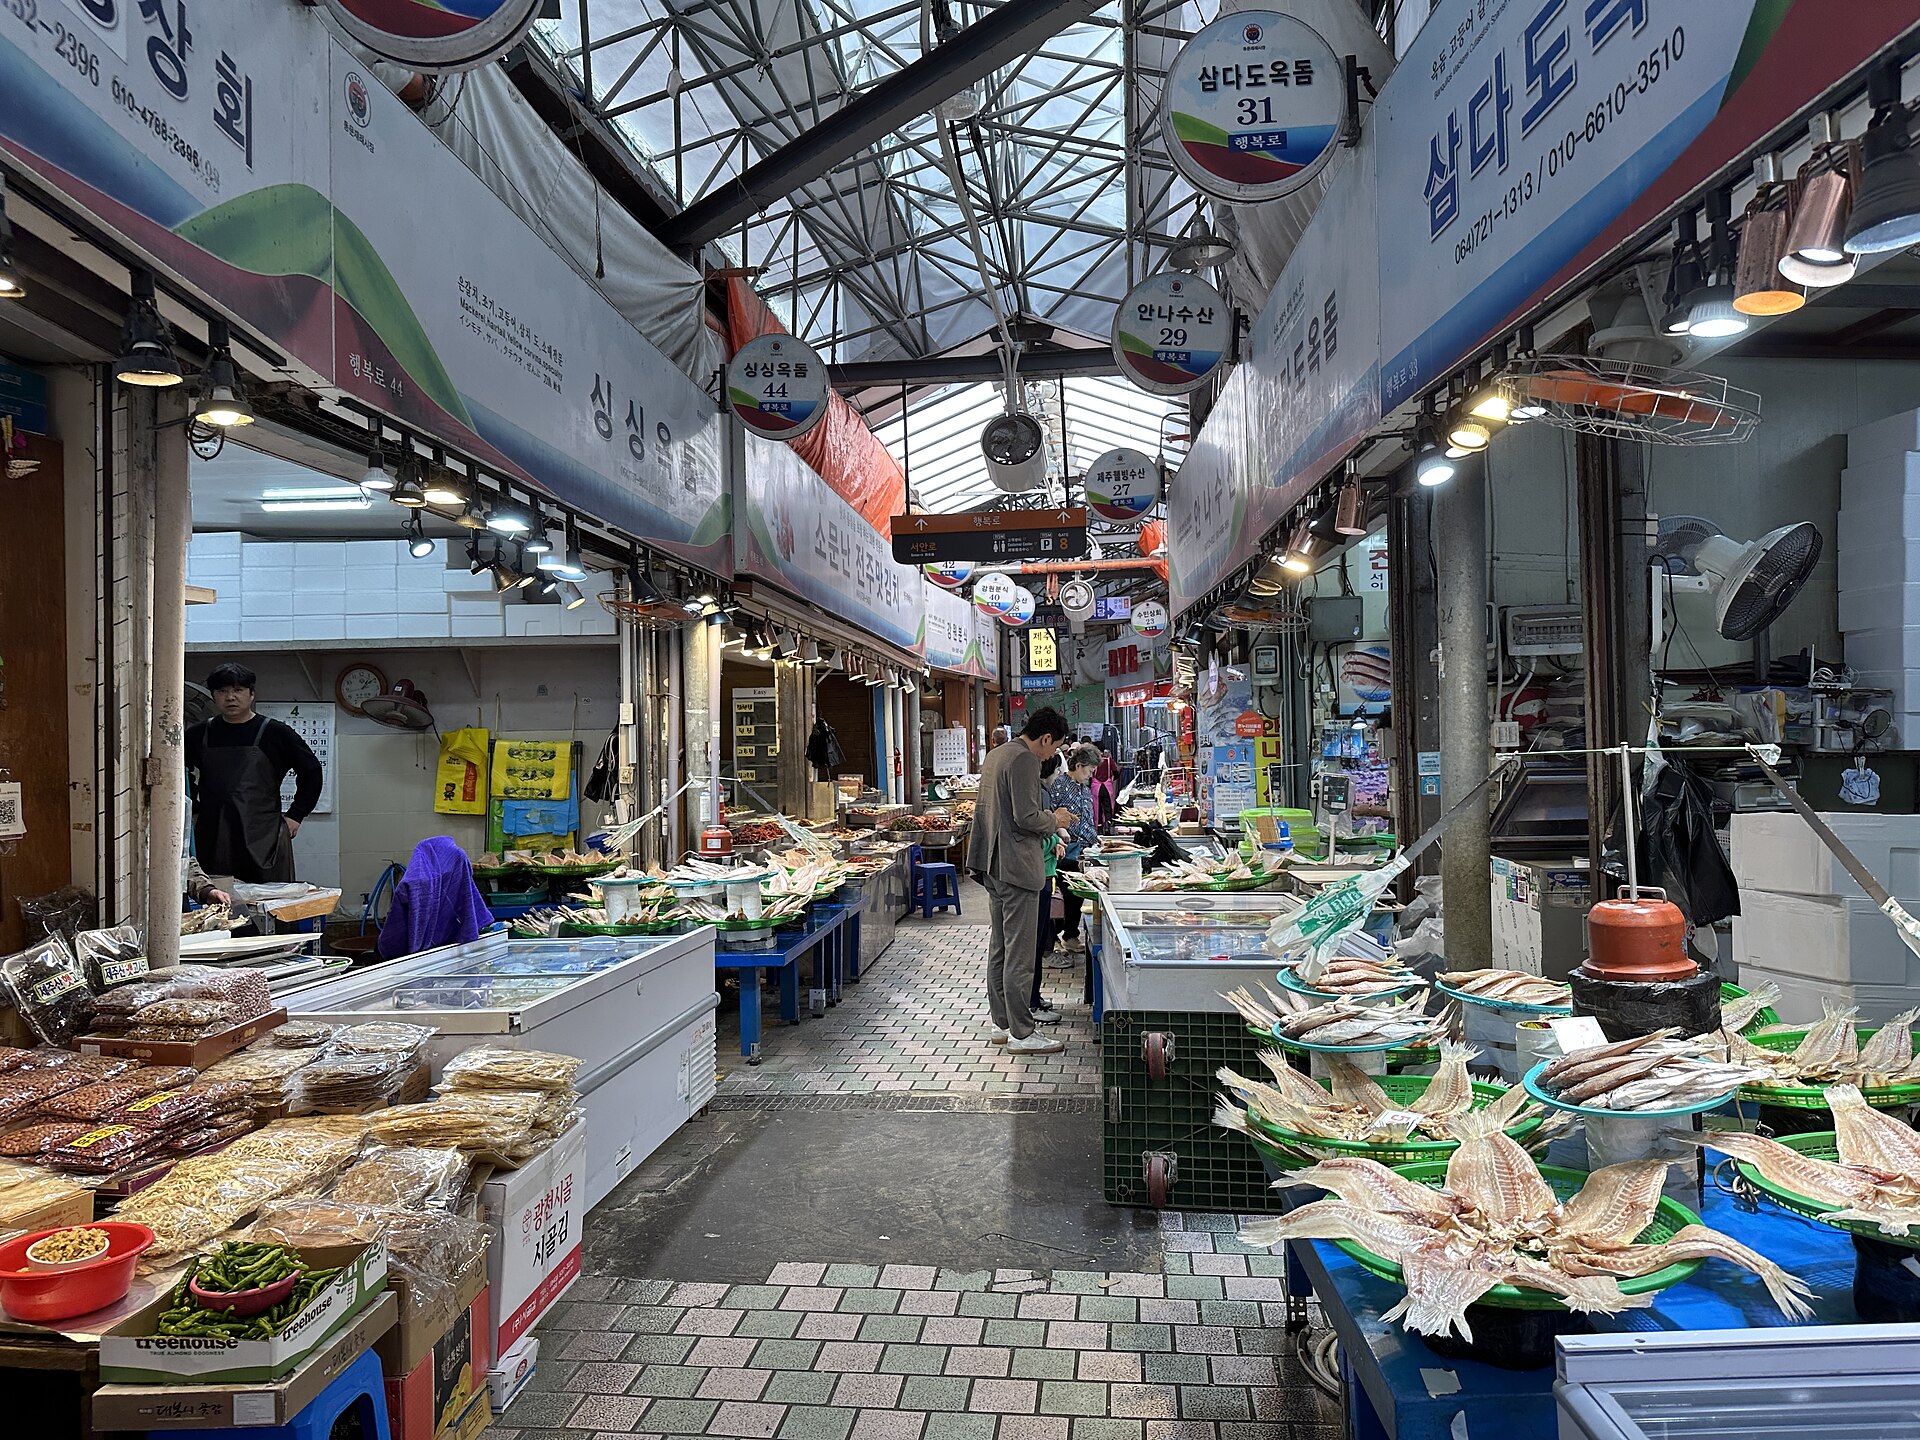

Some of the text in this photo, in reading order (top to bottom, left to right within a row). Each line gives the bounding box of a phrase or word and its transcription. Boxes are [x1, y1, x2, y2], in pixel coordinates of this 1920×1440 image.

[1449, 8, 1474, 58] 고등어
[1198, 59, 1314, 92] 삼다도옥돔
[1237, 97, 1277, 126] 31
[1233, 134, 1282, 150] 행복로
[1454, 171, 1533, 264] 064)721-1313
[1549, 26, 1685, 177] 010-6610-3510
[1138, 304, 1214, 324] 안나수산
[1159, 328, 1187, 346] 29
[349, 353, 403, 397] 행복로 44
[744, 362, 808, 378] 싱싱옥돔
[763, 382, 788, 398] 44
[590, 373, 697, 495] 싱싱옥돔
[1097, 468, 1145, 482] 제주웰빙수산
[1113, 484, 1130, 496] 27
[973, 515, 1000, 527] 행복로
[815, 512, 850, 578] 소문난
[910, 542, 937, 552] 서안로
[1059, 537, 1069, 550] 8
[1033, 631, 1052, 641] 제주
[1034, 645, 1052, 655] 감성
[1108, 645, 1138, 677] BYC
[290, 705, 299, 717] 4
[533, 1172, 573, 1232] 광천시골
[533, 1210, 570, 1267] 시골김
[282, 1294, 333, 1342] treehouse
